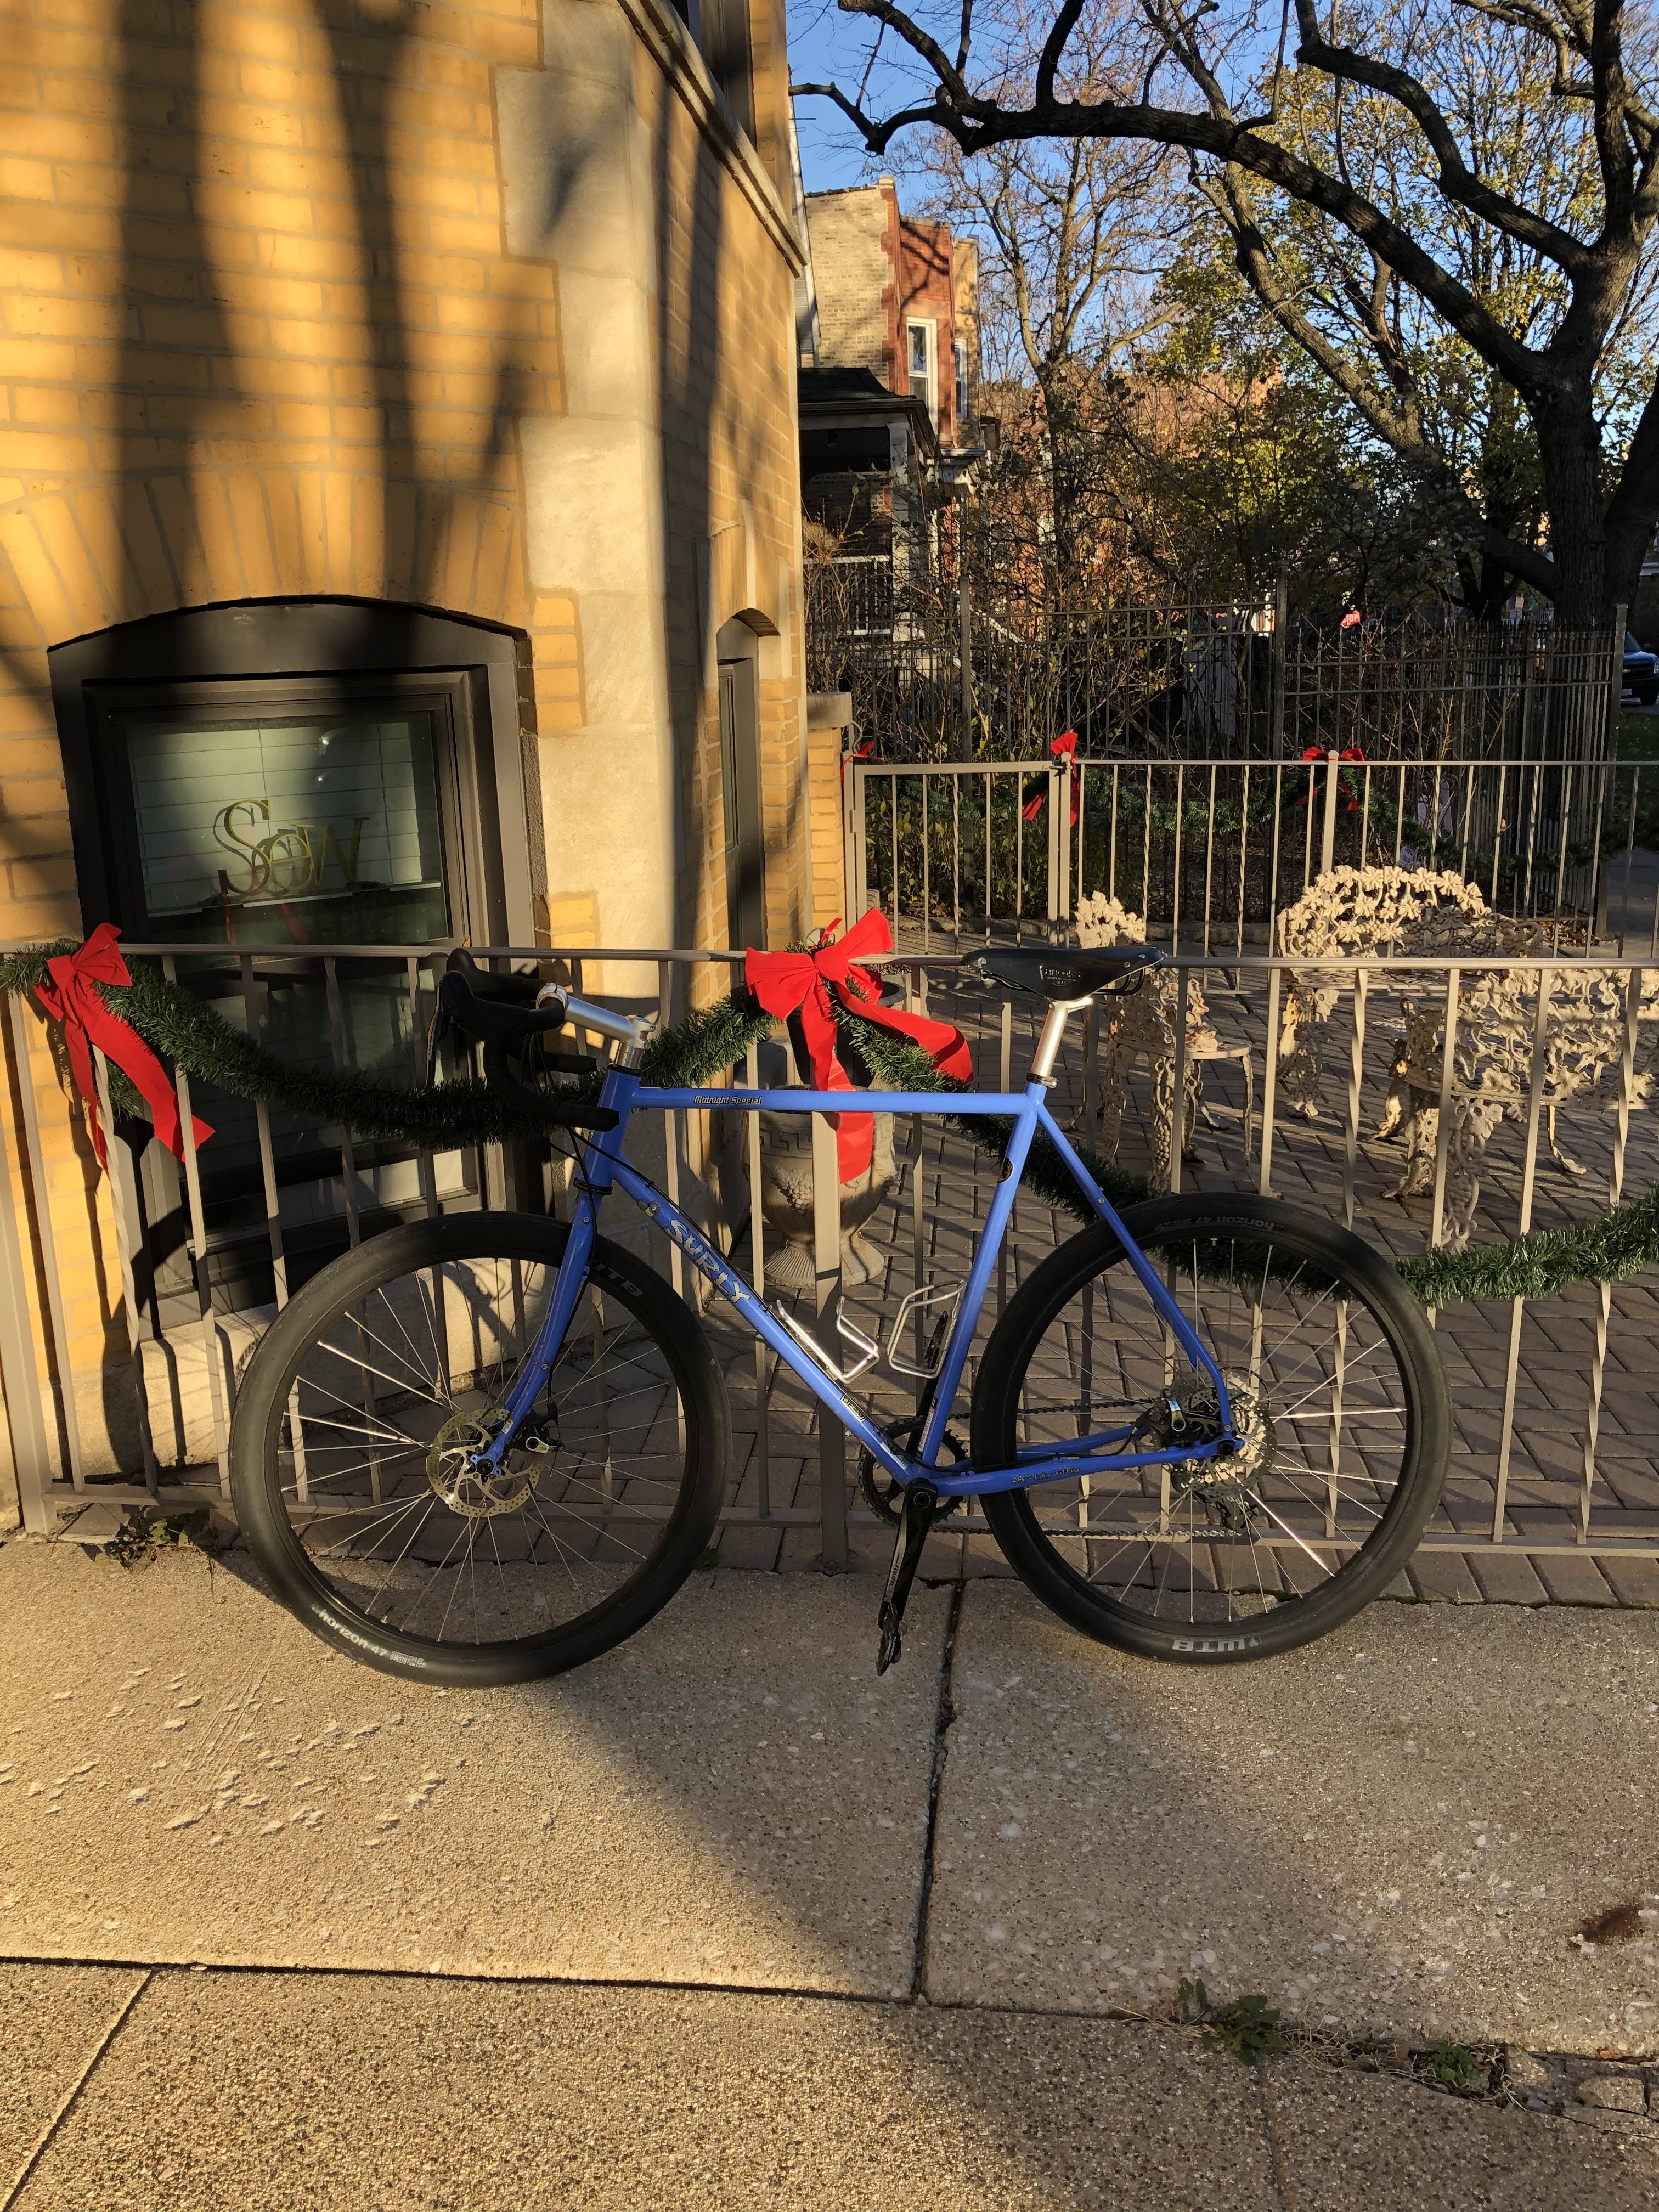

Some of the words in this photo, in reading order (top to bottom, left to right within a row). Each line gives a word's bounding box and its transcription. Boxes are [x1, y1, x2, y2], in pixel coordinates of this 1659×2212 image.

[694, 1096, 730, 1105] Midnight
[731, 1096, 762, 1105] Special
[1195, 1216, 1213, 1224] 47
[1217, 1216, 1274, 1231] horizon
[663, 1219, 751, 1303] SURLY
[318, 1609, 369, 1649] horizon
[370, 1646, 388, 1657] 47
[1172, 1639, 1245, 1652] WTB
